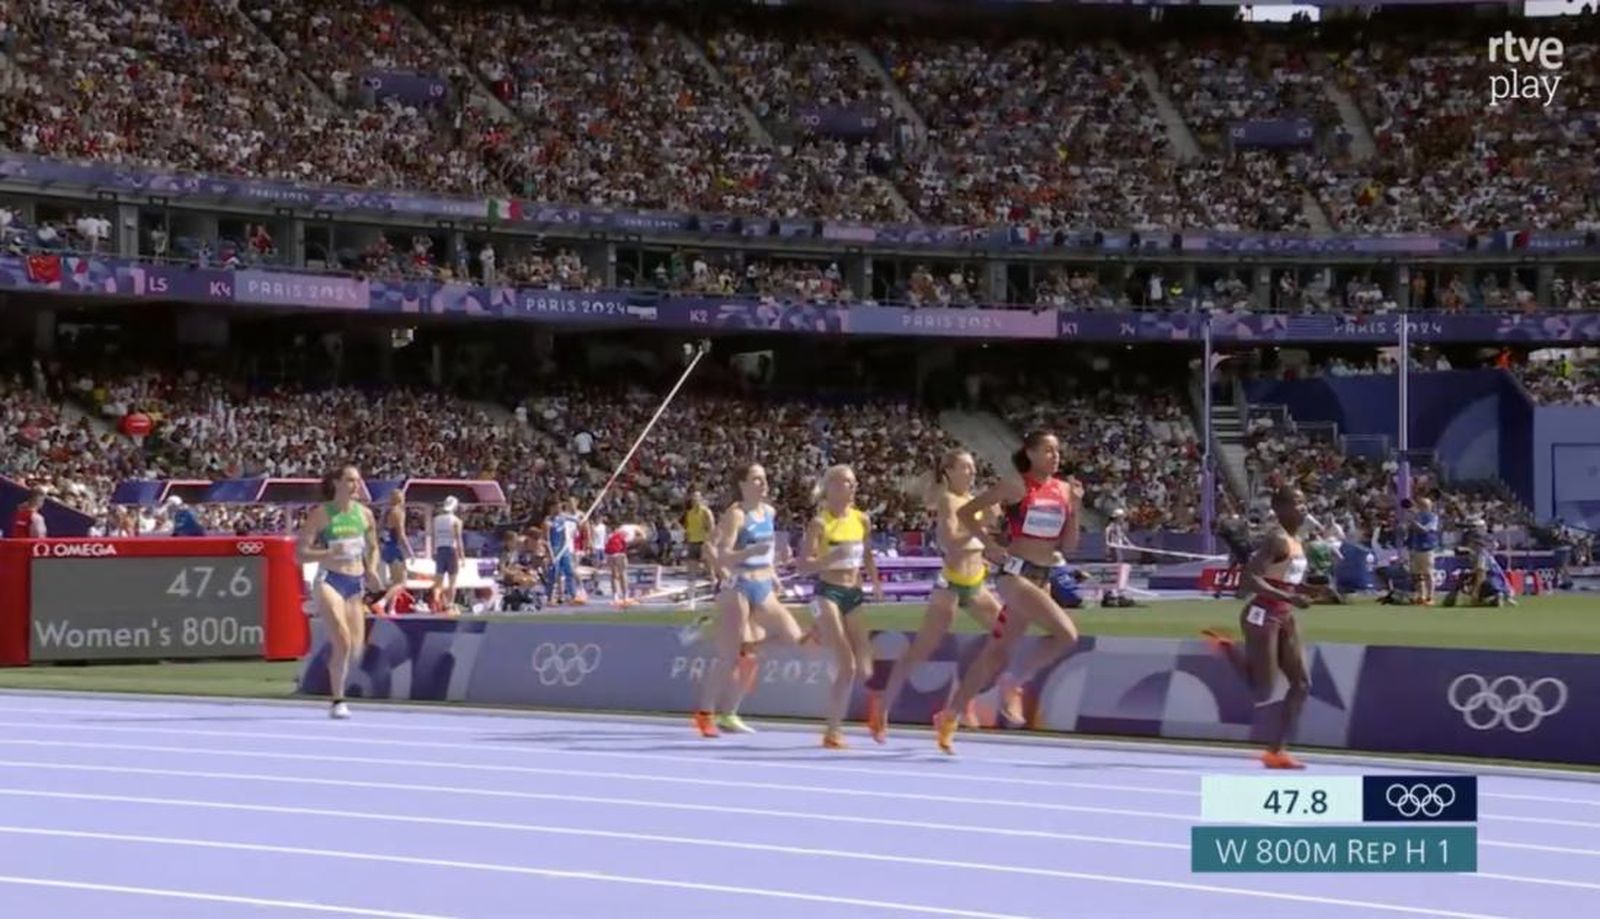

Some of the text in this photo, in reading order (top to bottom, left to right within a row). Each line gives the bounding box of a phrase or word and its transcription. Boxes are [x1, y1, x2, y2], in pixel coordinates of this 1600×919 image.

[249, 280, 358, 301] PARIS 2024
[526, 298, 626, 314] PARIS 2024
[690, 309, 709, 324] K2
[901, 314, 1002, 328] PARIS 2024
[54, 543, 117, 557] OMEGA
[166, 566, 252, 598] 47.6
[34, 617, 264, 648] Women's 800m
